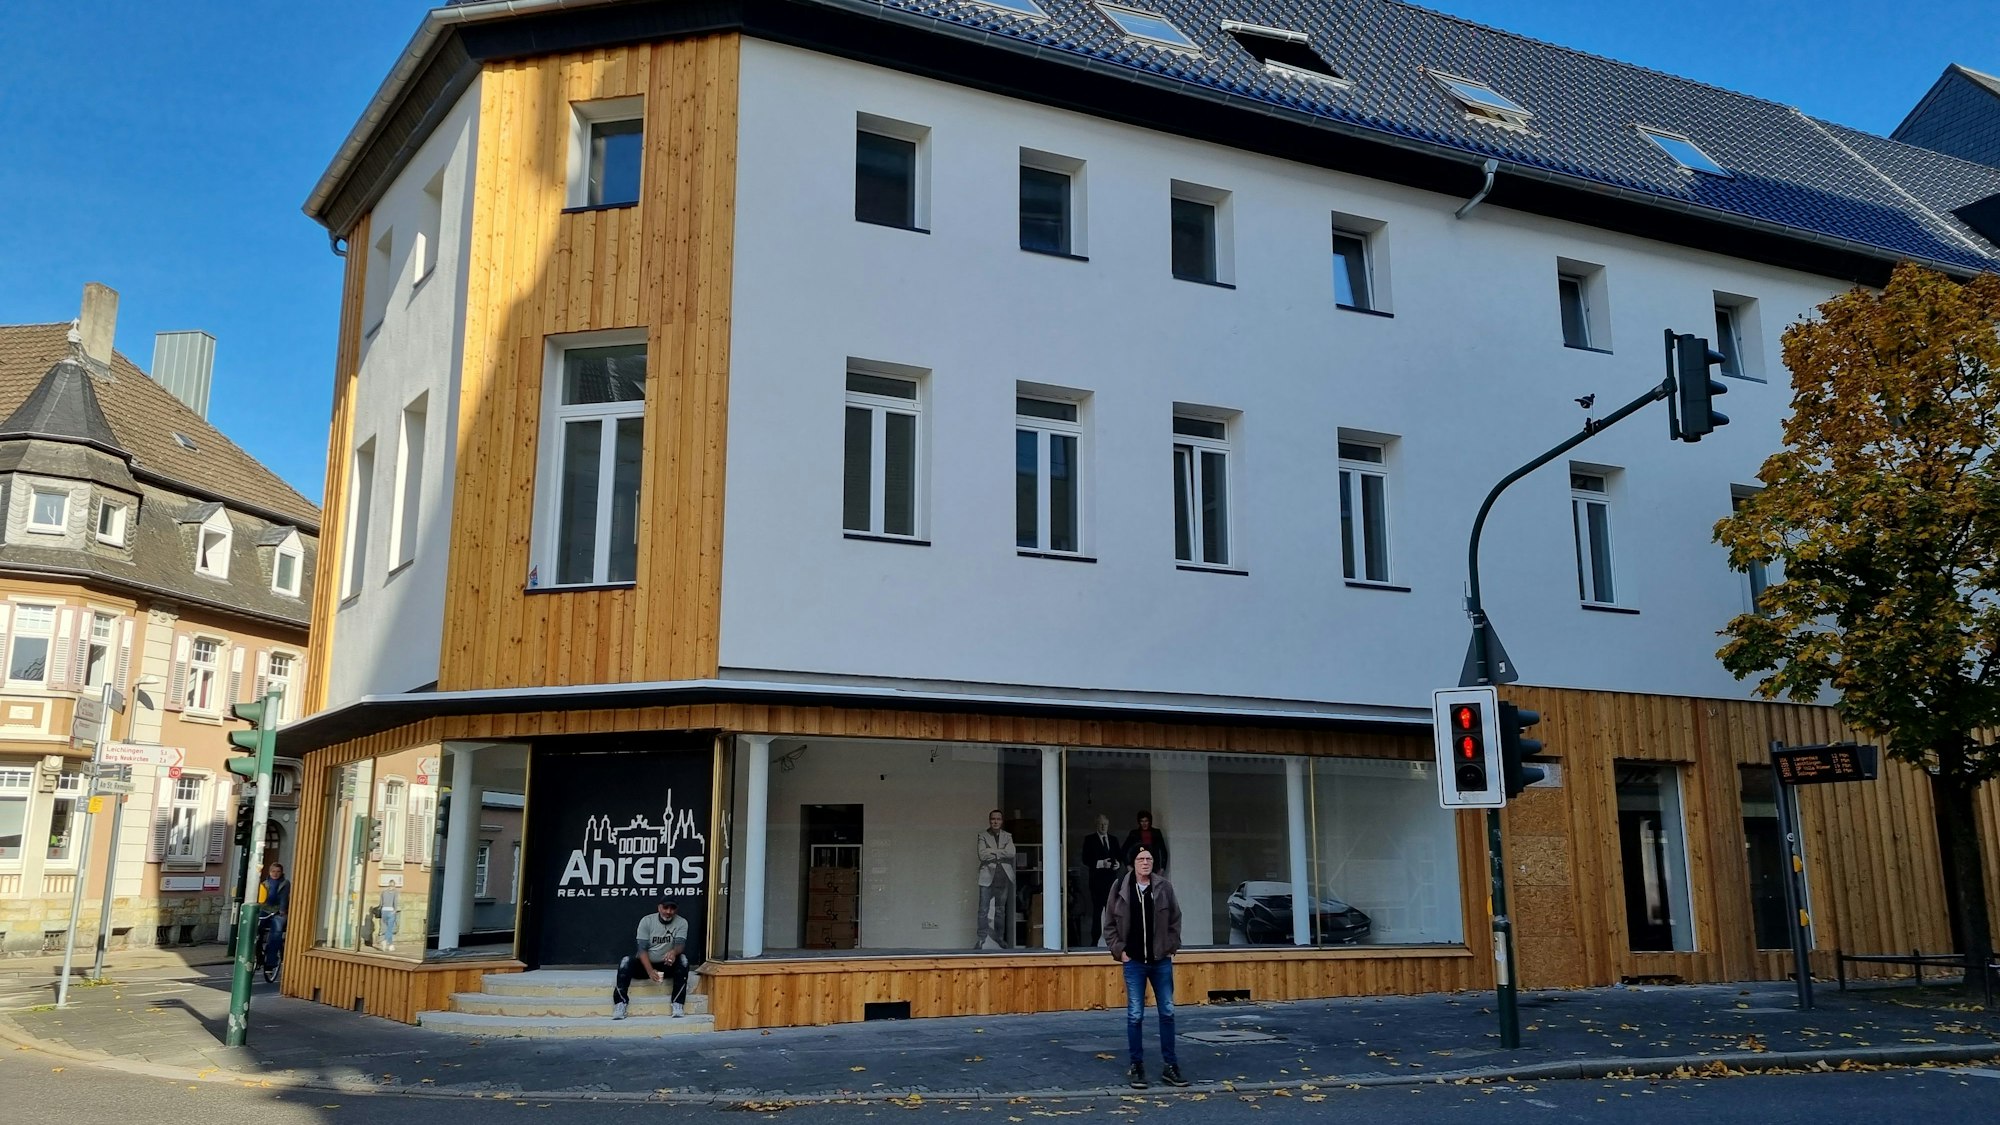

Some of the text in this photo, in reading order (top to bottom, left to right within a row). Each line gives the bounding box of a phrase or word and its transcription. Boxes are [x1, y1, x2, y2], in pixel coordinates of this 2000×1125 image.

[106, 746, 144, 755] Leichlingen
[120, 754, 149, 763] Neukirchen
[559, 849, 705, 886] Ahrens
[557, 888, 596, 897] REAL
[600, 887, 658, 896] ESTATE
